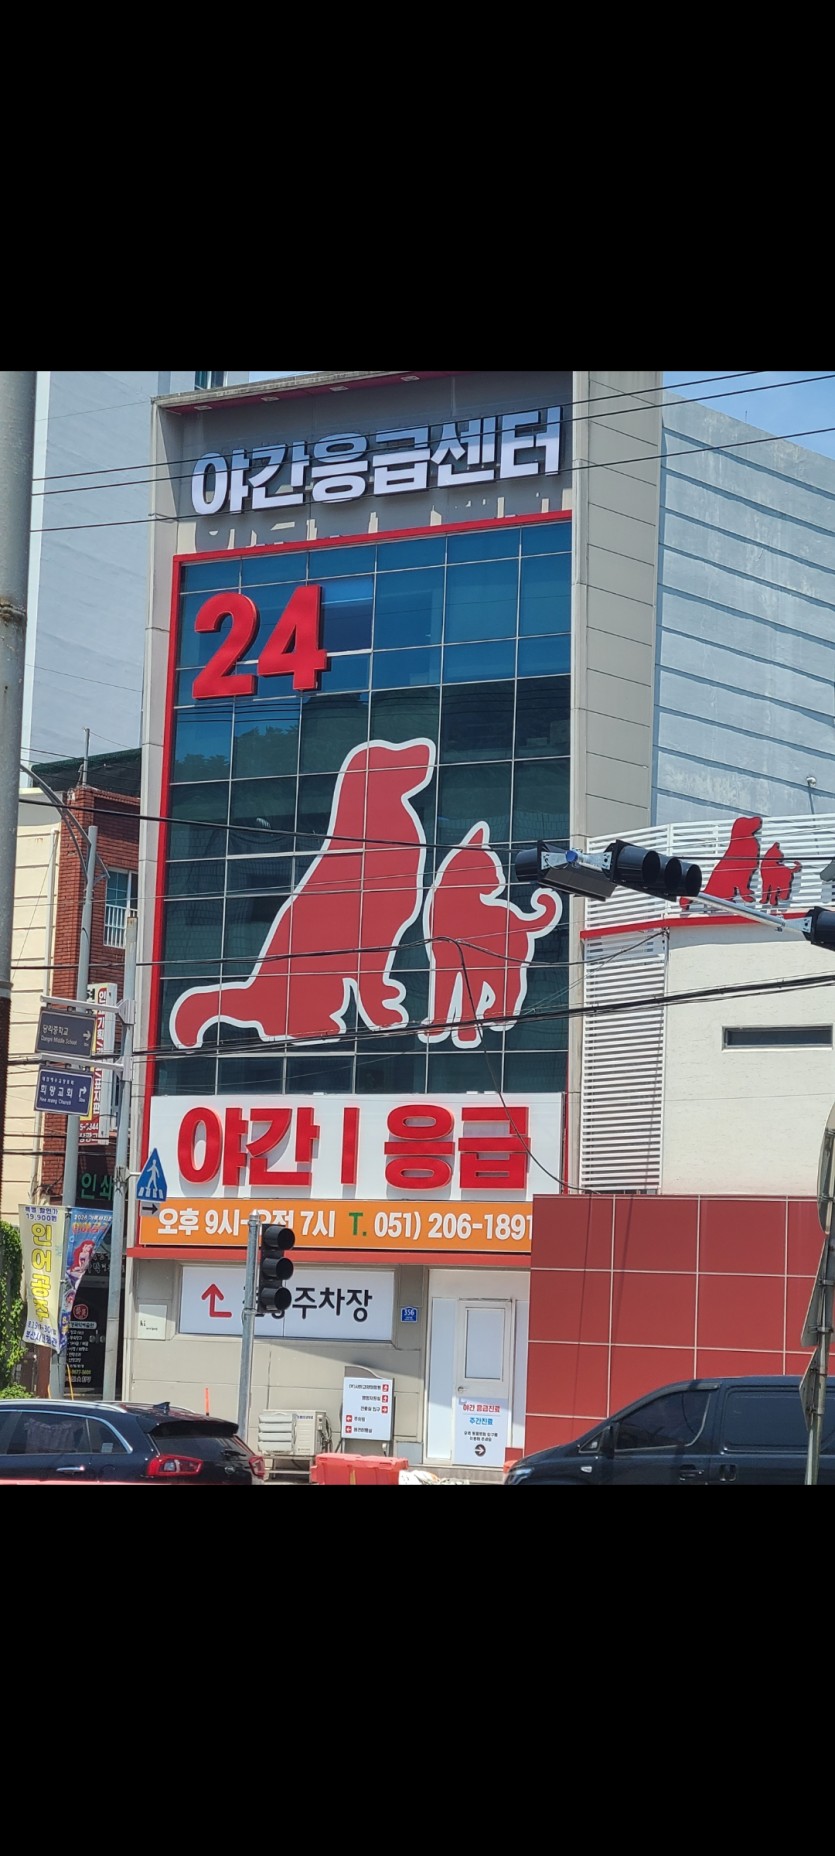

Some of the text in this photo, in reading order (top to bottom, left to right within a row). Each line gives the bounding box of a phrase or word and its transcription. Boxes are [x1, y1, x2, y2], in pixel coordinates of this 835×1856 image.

[191, 404, 562, 516] 야간응급센터
[192, 584, 328, 700] 24
[40, 1084, 74, 1099] 희망교회
[177, 1106, 321, 1187] 야간
[383, 1104, 531, 1190] 응급
[157, 1208, 200, 1236] 오후
[301, 1209, 336, 1238] 7시
[348, 1211, 368, 1237] T.
[374, 1211, 422, 1240] 051)
[427, 1213, 533, 1241] 206-1891
[31, 1222, 53, 1323] 인어공주
[463, 1403, 501, 1413] 야간 응급진료
[469, 1416, 494, 1426] 주간진료
